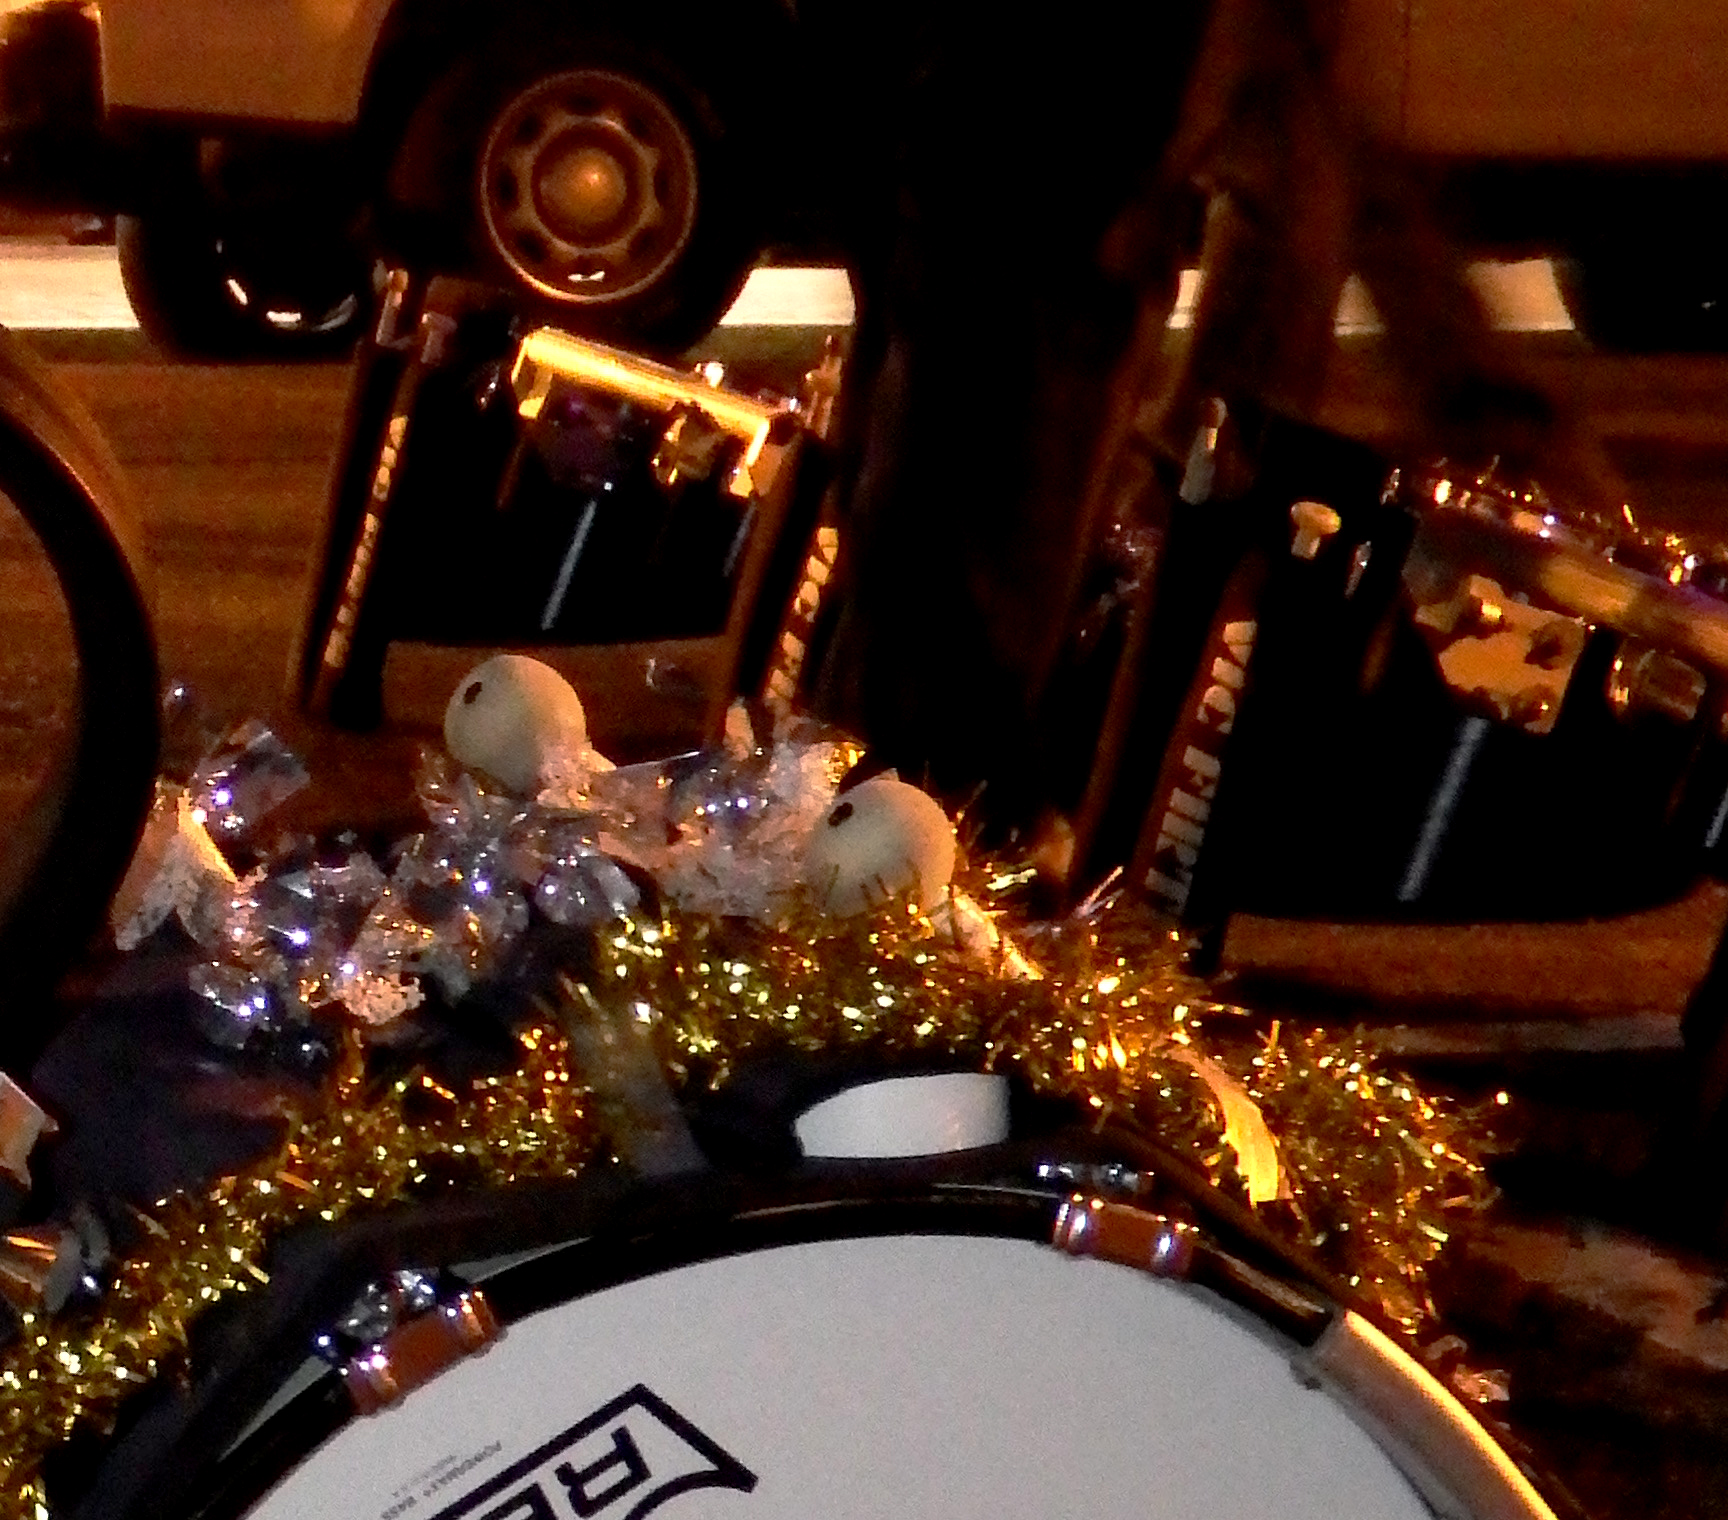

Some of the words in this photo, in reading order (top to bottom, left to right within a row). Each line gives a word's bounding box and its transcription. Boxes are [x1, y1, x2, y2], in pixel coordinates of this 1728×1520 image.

[794, 526, 839, 623] VIC
[1196, 619, 1258, 735] VIC
[1144, 744, 1221, 916] FIRT
